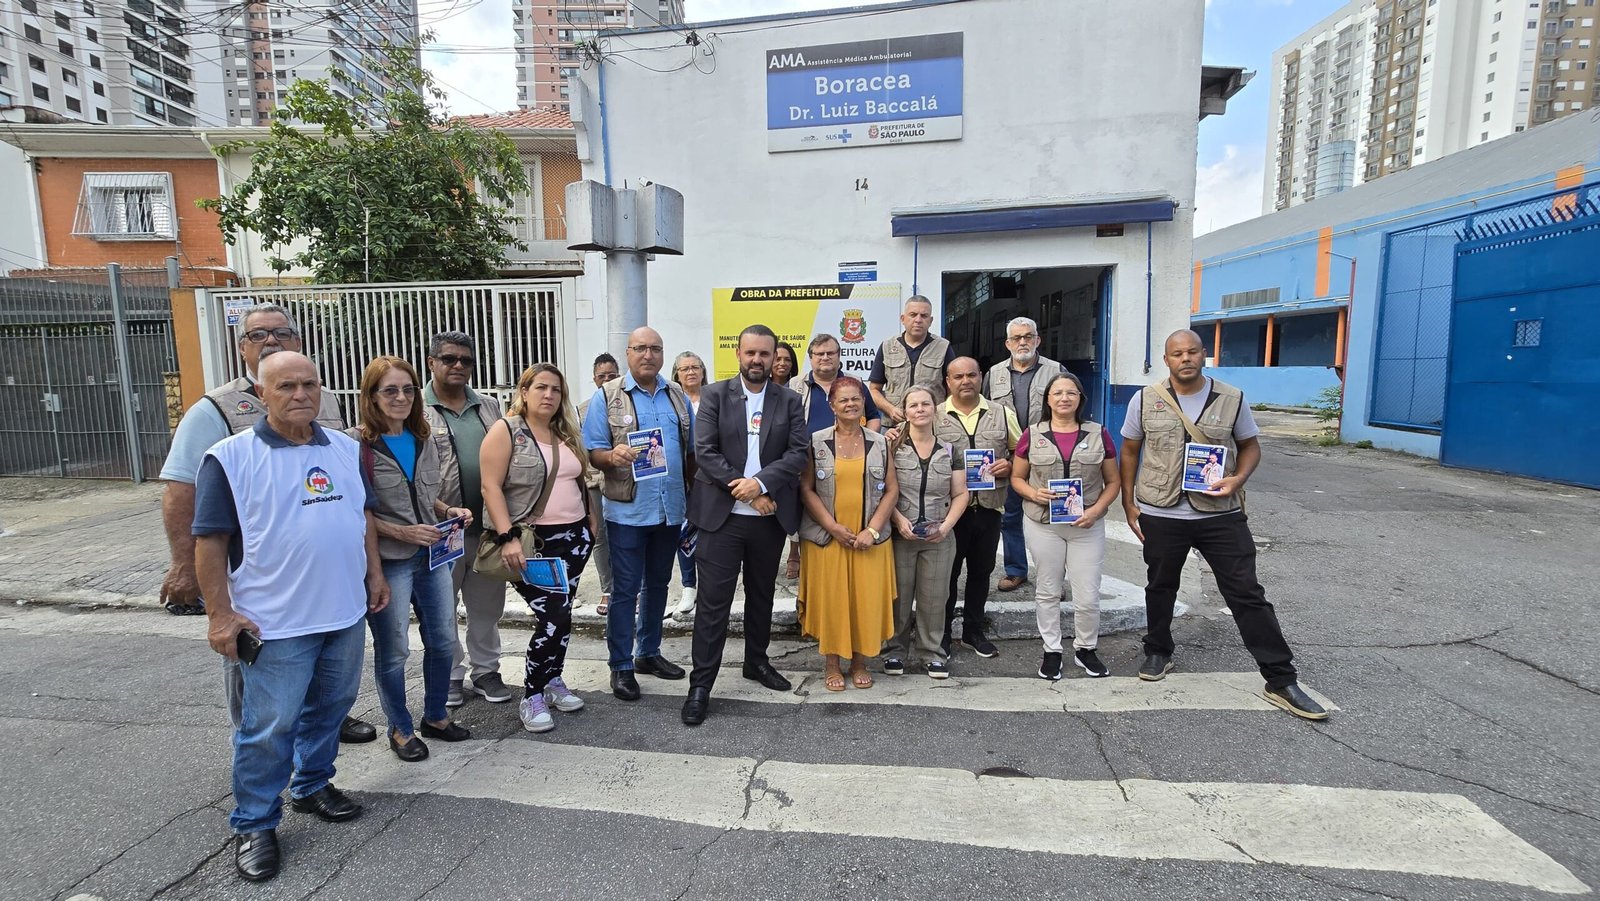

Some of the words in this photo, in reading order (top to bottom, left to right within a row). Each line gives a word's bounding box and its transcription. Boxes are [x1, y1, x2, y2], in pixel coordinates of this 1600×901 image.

[769, 53, 805, 69] AMA
[807, 58, 843, 66] Assistência
[869, 51, 912, 61] Ambulatorial
[815, 74, 911, 96] Boracea
[789, 106, 814, 121] Dr.
[821, 102, 859, 119] Luiz
[865, 95, 938, 115] Baccalá
[880, 123, 916, 131] PREFEITURA
[880, 129, 897, 139] SÃO
[898, 129, 925, 138] PAULO
[855, 177, 869, 191] 14
[740, 289, 766, 298] OBRA
[769, 289, 782, 297] DA
[785, 287, 840, 297] PREFEITURA
[789, 333, 806, 341] SAÚDE
[841, 348, 875, 356] EITURA
[846, 360, 875, 371] PAU
